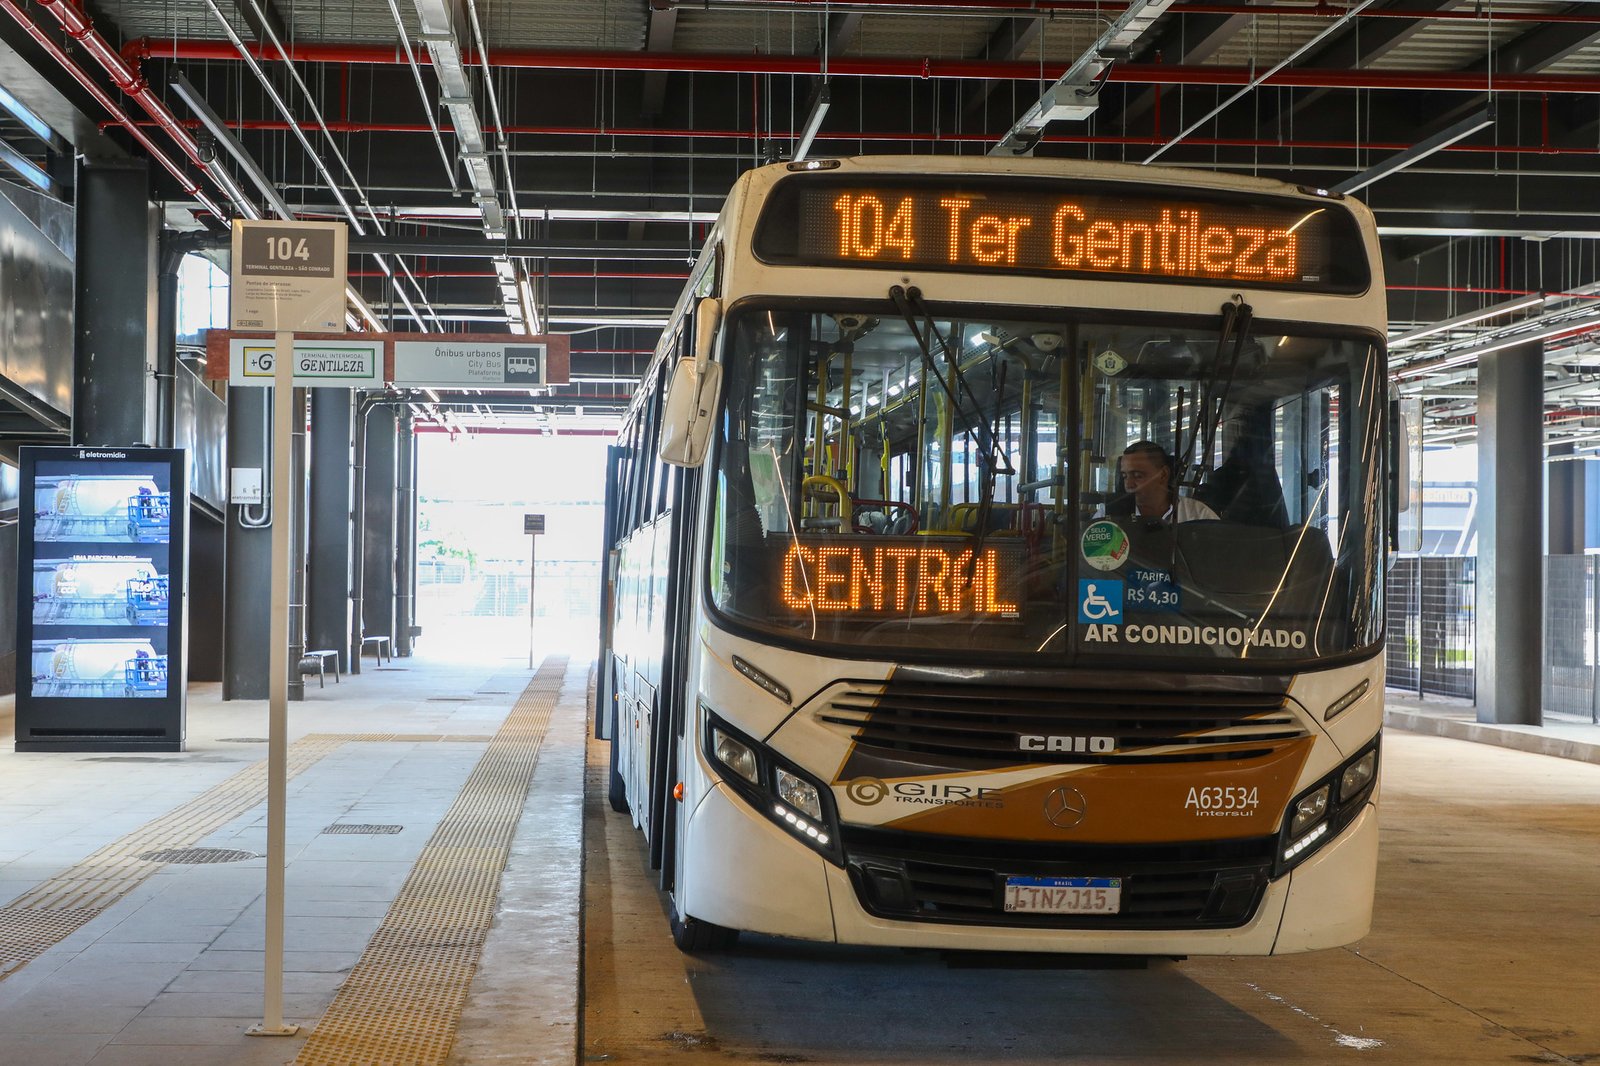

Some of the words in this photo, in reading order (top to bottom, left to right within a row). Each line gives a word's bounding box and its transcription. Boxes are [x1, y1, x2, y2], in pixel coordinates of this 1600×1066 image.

[833, 194, 915, 259] 104
[940, 198, 1032, 263] Ter
[1053, 204, 1297, 276] Gentileza
[266, 237, 310, 261] 104
[434, 347, 464, 358] Ônibus
[466, 349, 501, 358] urbanos
[300, 358, 365, 373] GENTILEZA
[468, 360, 483, 369] City
[486, 360, 502, 368] Bus
[85, 451, 126, 459] eletromidia
[1085, 532, 1111, 541] VERDE
[783, 546, 1017, 612] CENTRAL
[1136, 570, 1171, 583] TARIFA
[1127, 587, 1145, 603] R$
[1148, 590, 1178, 605] 4,30
[1084, 623, 1119, 643] AR
[1125, 624, 1307, 649] CONDICIONADO
[1019, 735, 1116, 753] CAIO
[893, 782, 1003, 802] GIRE
[1184, 786, 1260, 809] A63534
[893, 795, 1005, 809] TRANSPORTES
[1196, 809, 1254, 817] intersul
